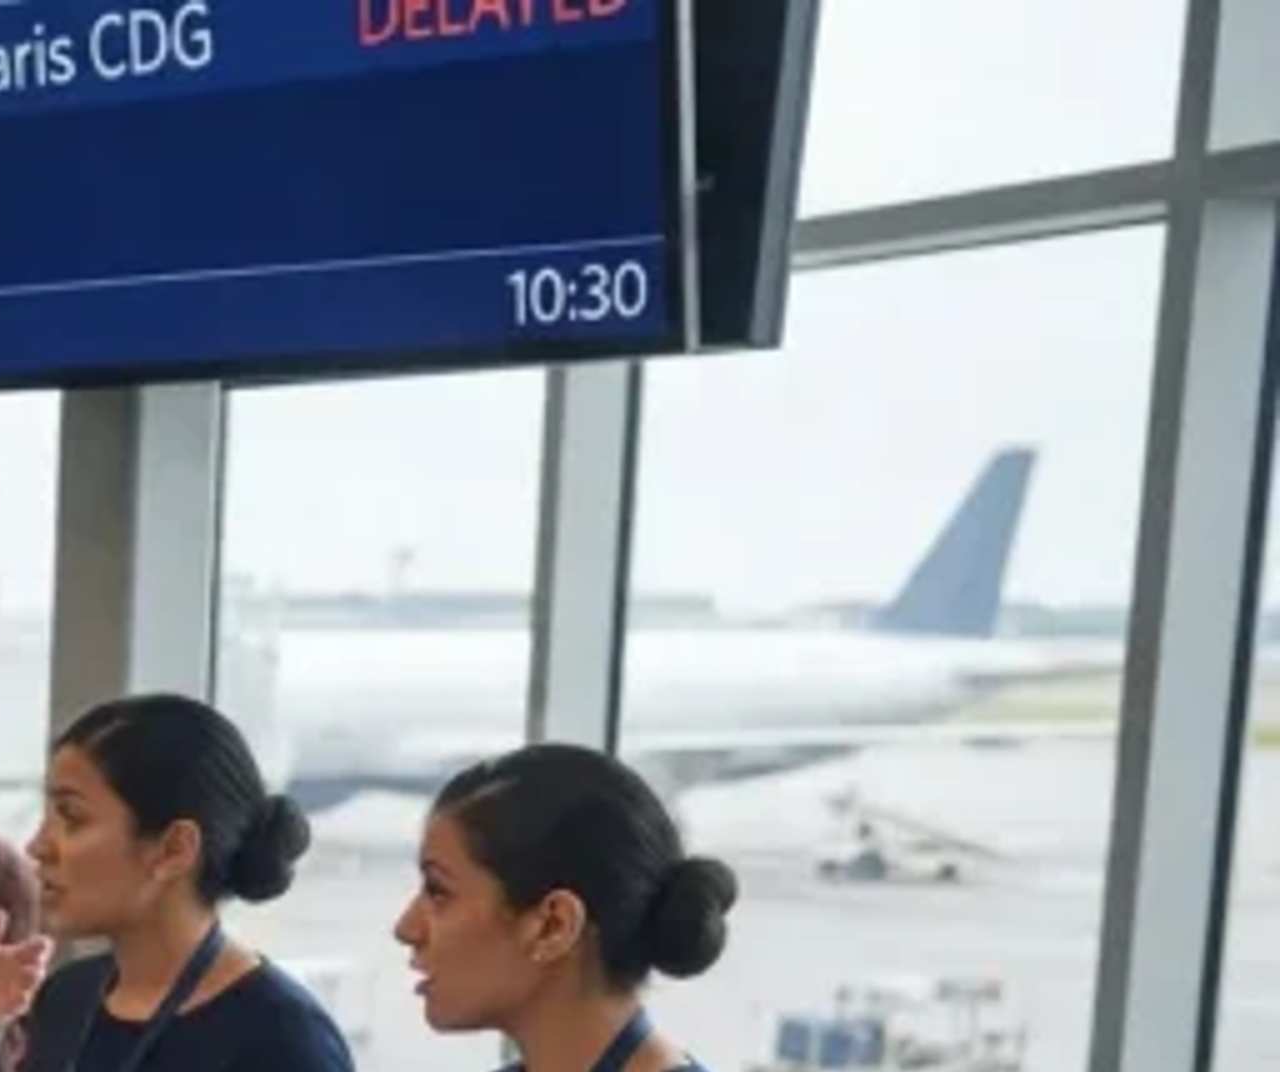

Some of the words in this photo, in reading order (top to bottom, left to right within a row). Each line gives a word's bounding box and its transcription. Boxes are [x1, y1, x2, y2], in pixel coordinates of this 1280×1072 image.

[90, 1, 213, 79] CDG
[358, 0, 627, 46] DELA
[506, 260, 647, 326] 10:30
